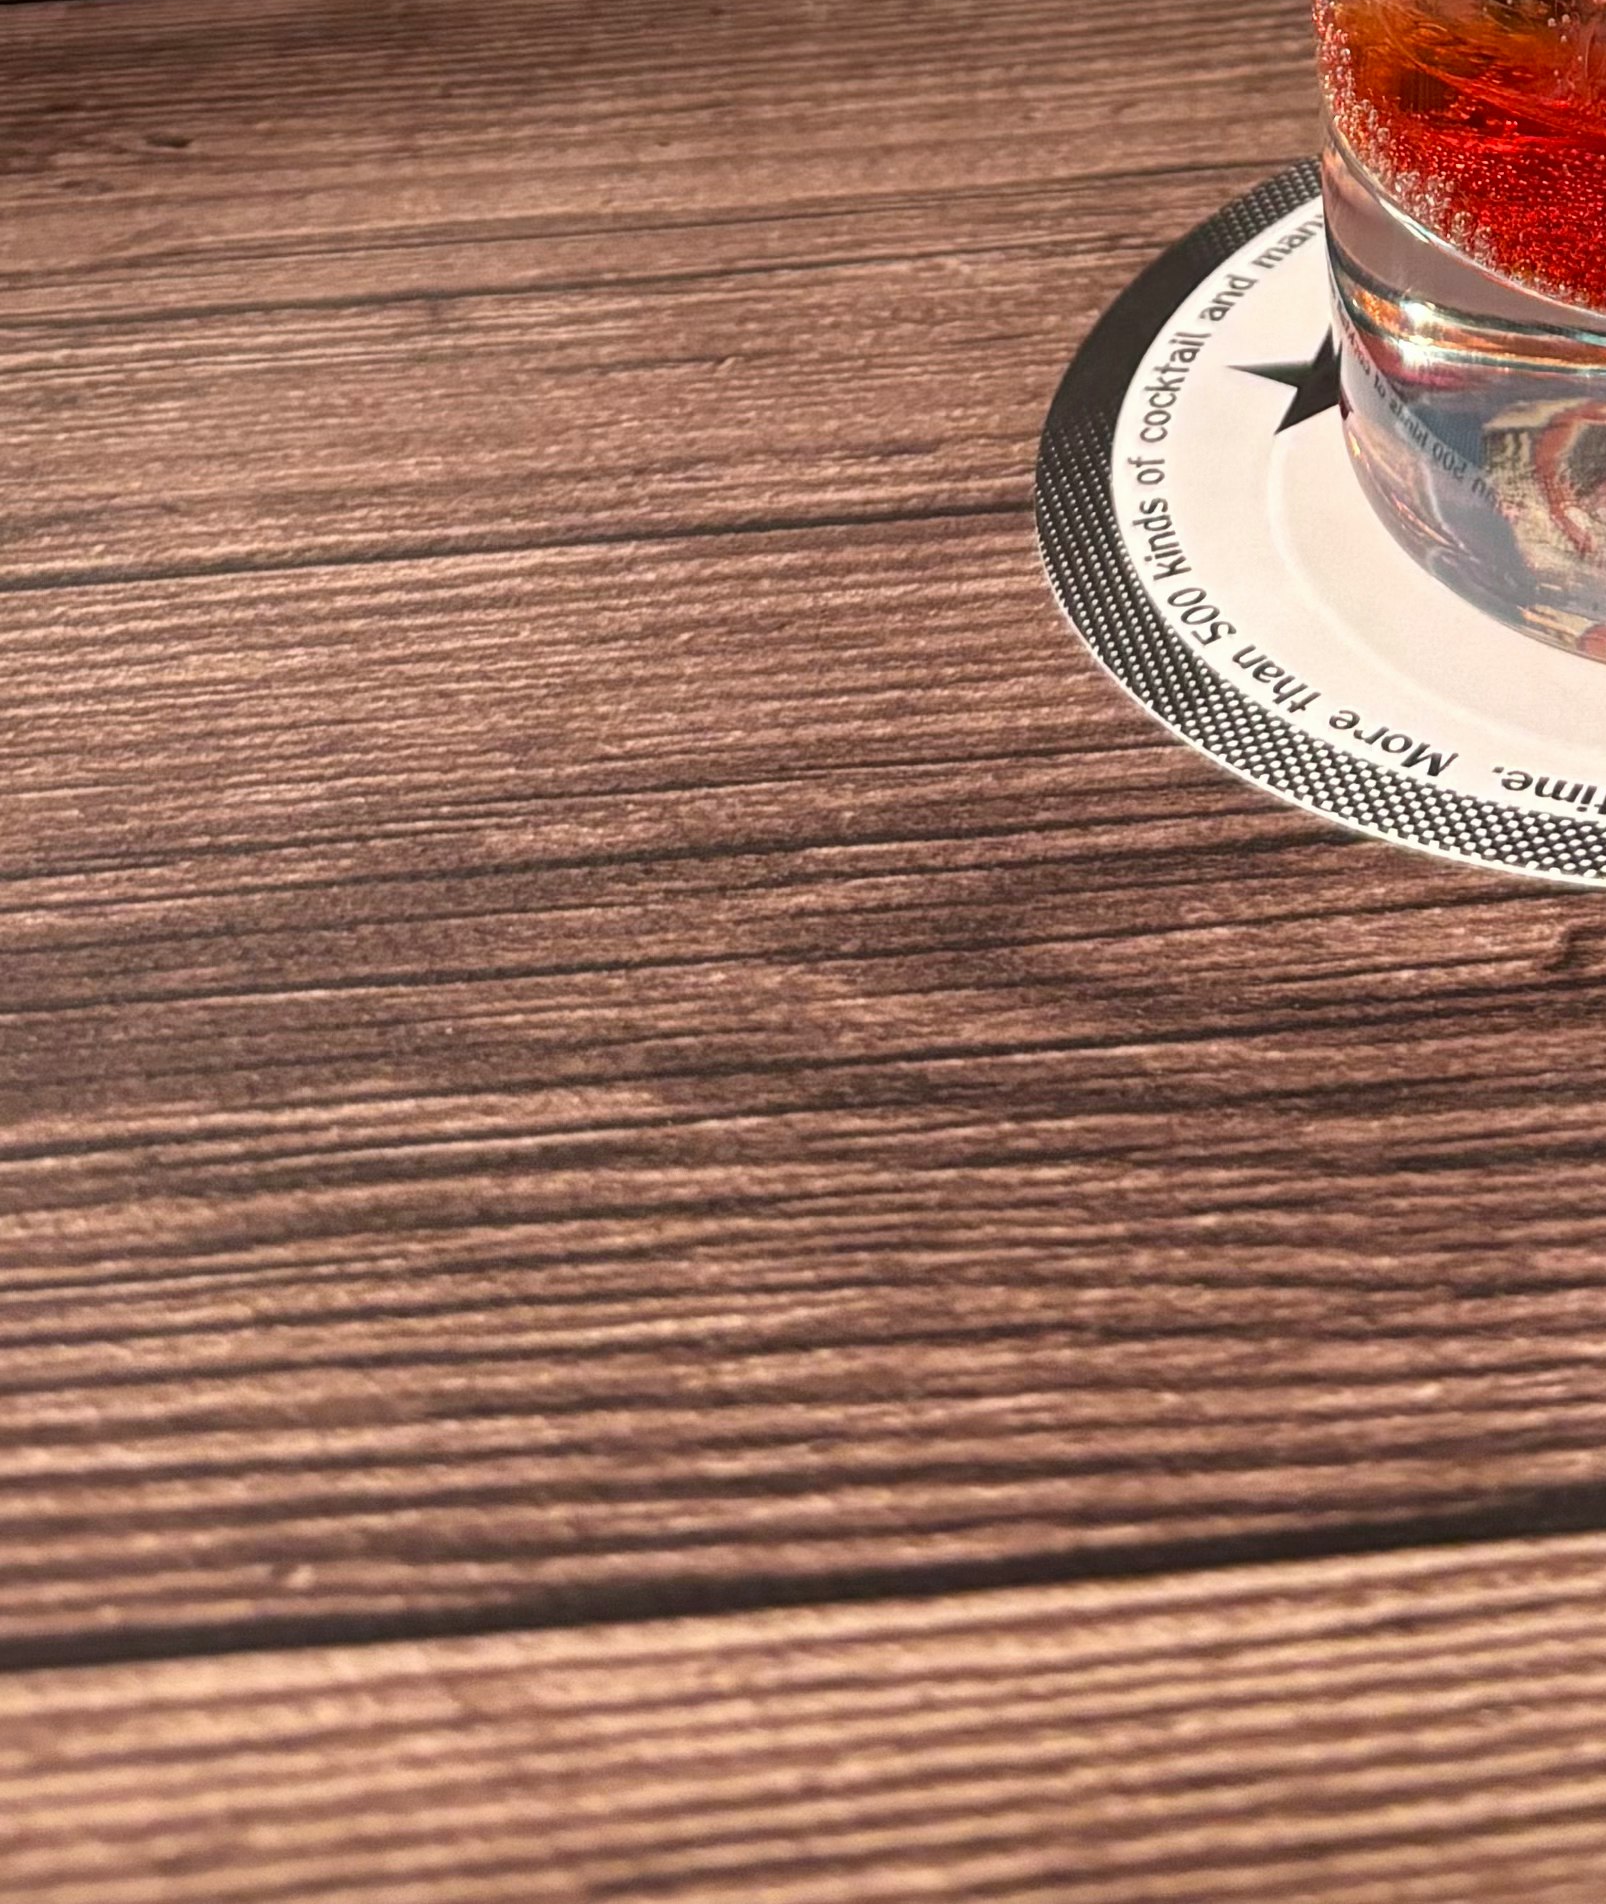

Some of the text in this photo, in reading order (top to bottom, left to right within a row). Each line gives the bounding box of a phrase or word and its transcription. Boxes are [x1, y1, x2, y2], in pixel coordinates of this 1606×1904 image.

[1199, 272, 1257, 325] and
[1138, 330, 1212, 444] cocktail
[1128, 455, 1164, 494] of
[1131, 496, 1191, 583] kinds
[1163, 585, 1238, 649] 500
[1231, 642, 1322, 712] than
[1326, 708, 1459, 778] More
